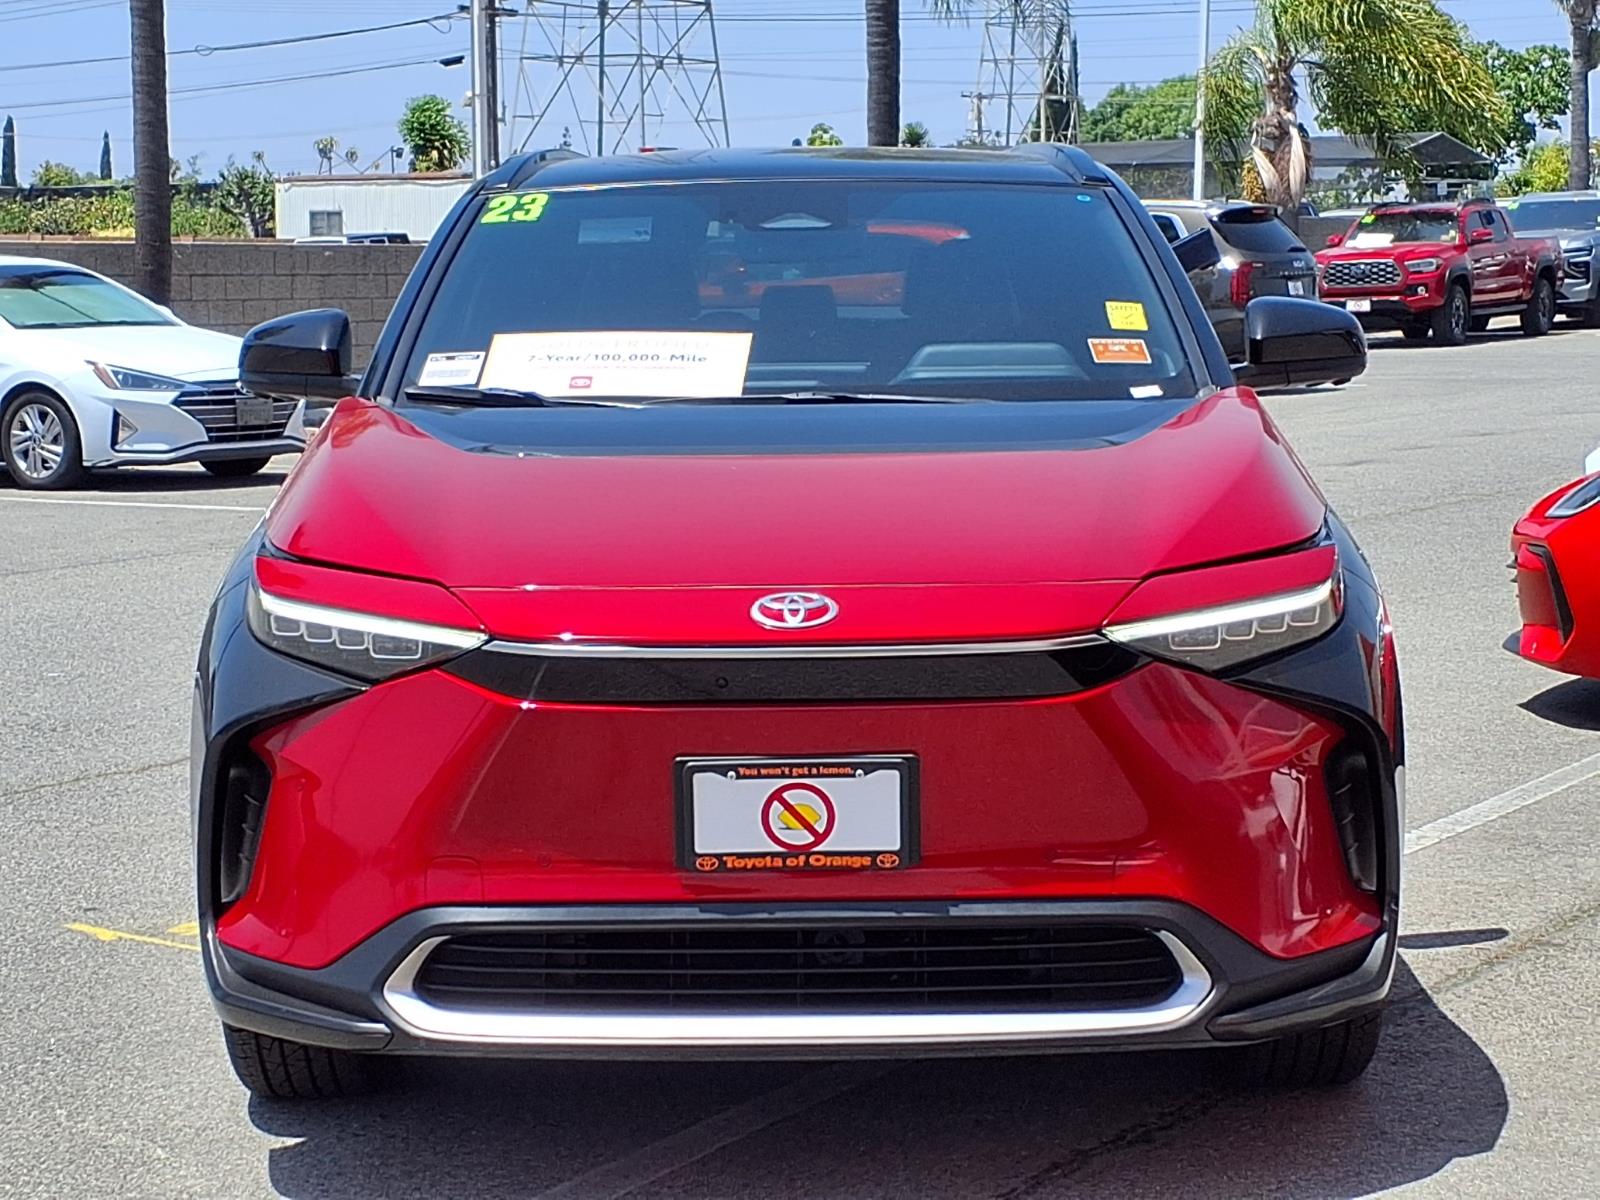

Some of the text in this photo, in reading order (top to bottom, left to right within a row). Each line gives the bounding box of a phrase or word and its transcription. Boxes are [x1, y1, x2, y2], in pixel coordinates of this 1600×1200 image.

[480, 192, 549, 224] 23
[738, 767, 758, 777] You
[760, 766, 790, 776] won't
[792, 767, 809, 777] get
[723, 854, 872, 869] Toyota of Orange
